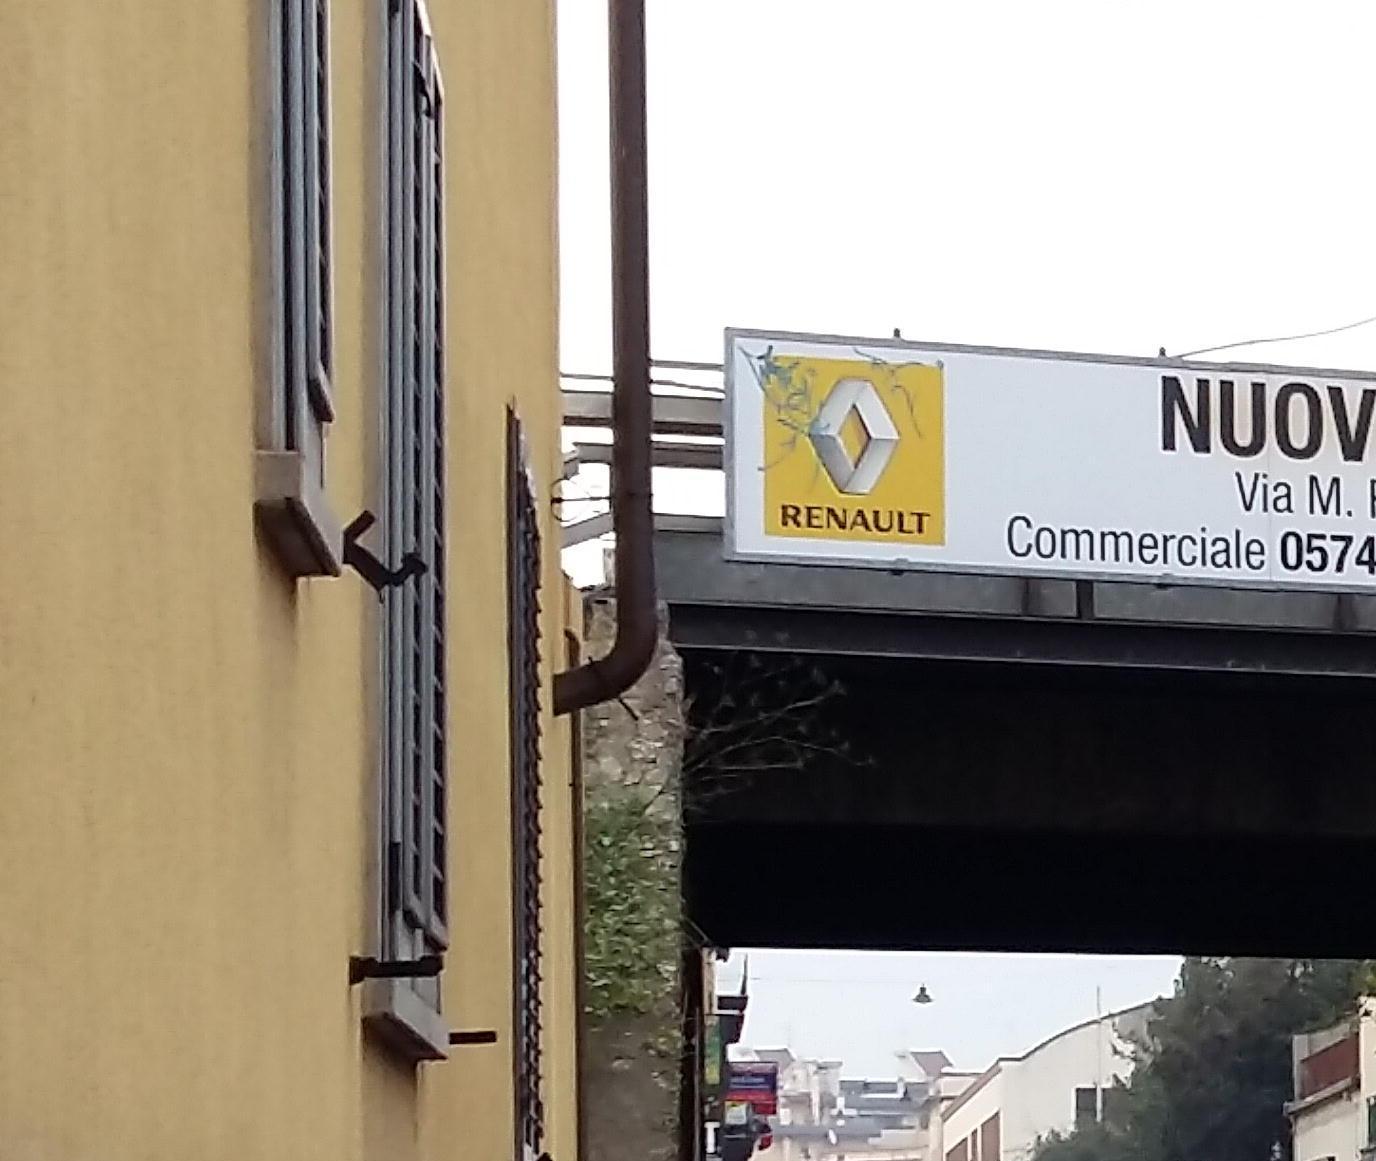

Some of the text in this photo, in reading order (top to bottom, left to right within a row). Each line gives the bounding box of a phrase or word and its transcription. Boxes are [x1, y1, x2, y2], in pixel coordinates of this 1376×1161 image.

[1236, 471, 1294, 515] Via
[1310, 474, 1352, 517] M.
[781, 504, 931, 535] RENAULT
[1007, 515, 1266, 572] Commerciale
